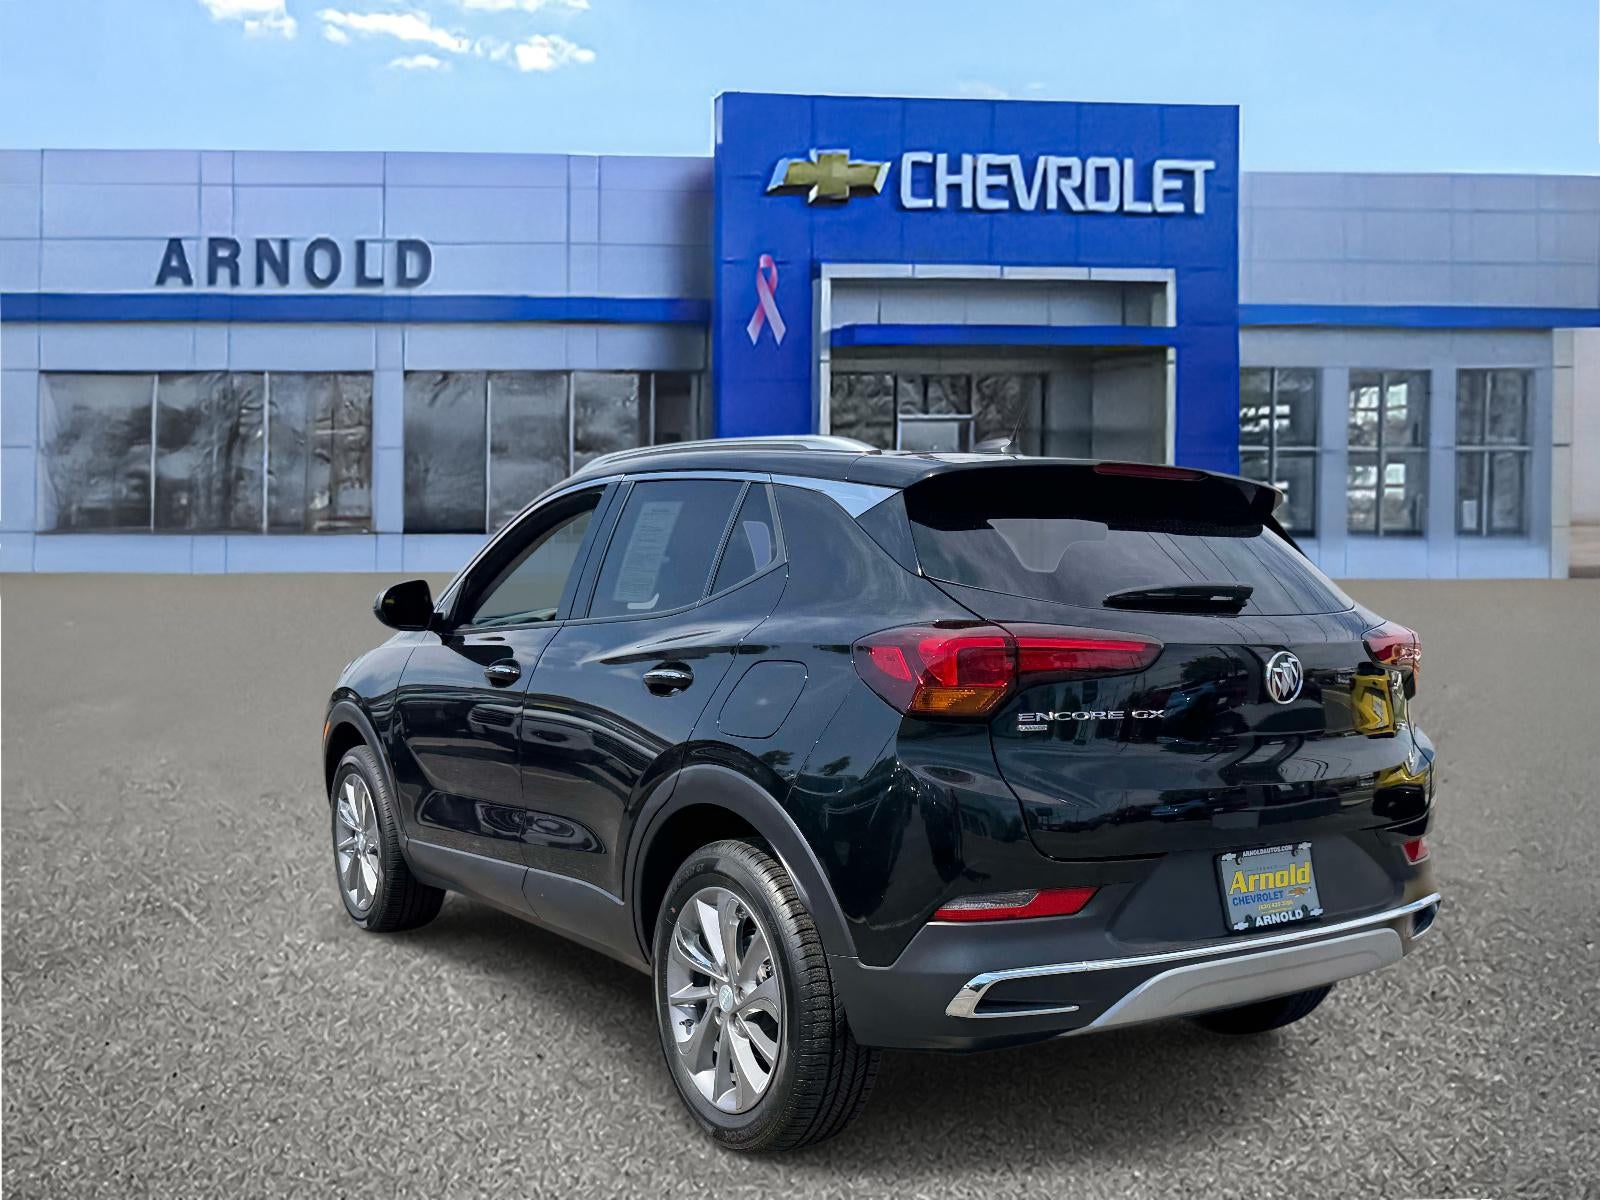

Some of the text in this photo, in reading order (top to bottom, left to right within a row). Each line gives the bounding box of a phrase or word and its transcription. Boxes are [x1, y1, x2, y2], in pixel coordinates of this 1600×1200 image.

[901, 151, 1215, 214] CHEVROLET
[155, 236, 432, 289] ARNOLD
[1017, 708, 1166, 722] ENCORE GX
[1242, 844, 1293, 858] ARNOLDAUTOS.COM
[1228, 861, 1311, 896] Arnold
[1232, 889, 1284, 907] CHEVROLET
[1255, 908, 1304, 928] ARNOLD
